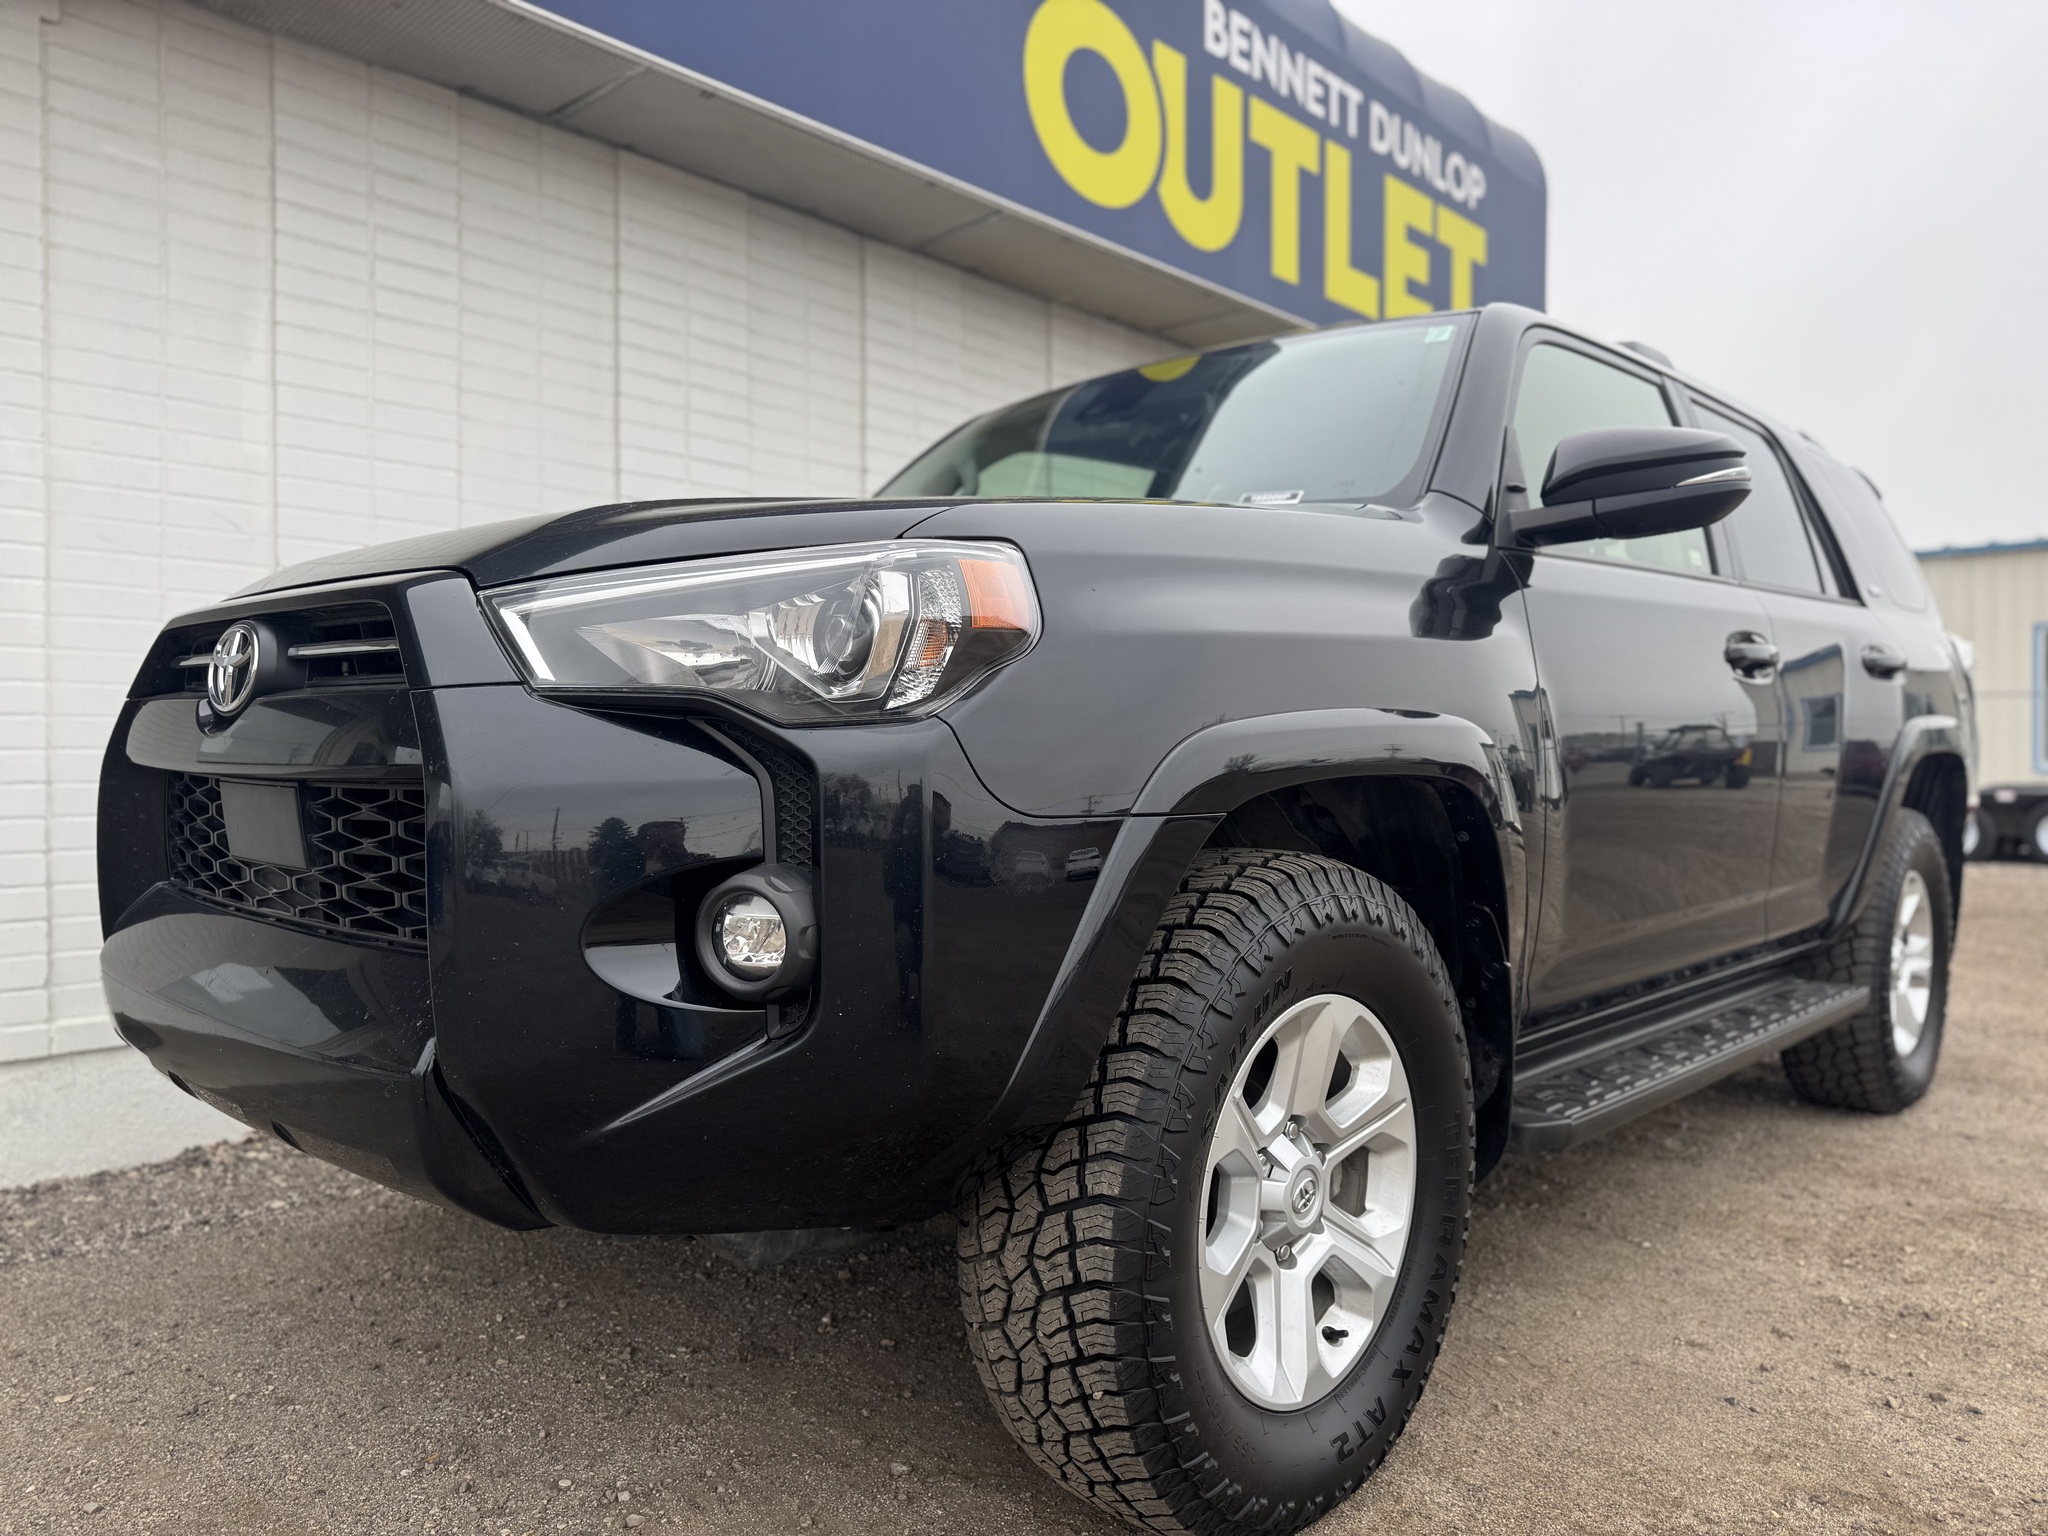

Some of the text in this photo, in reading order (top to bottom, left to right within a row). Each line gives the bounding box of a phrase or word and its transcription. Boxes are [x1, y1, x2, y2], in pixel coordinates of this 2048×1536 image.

[1024, 0, 1487, 320] OUTLET
[1203, 0, 1486, 209] BENNETT DUNLOP
[1201, 966, 1293, 1147] SAILUN
[1329, 1110, 1461, 1464] TERRAMAX AT2
